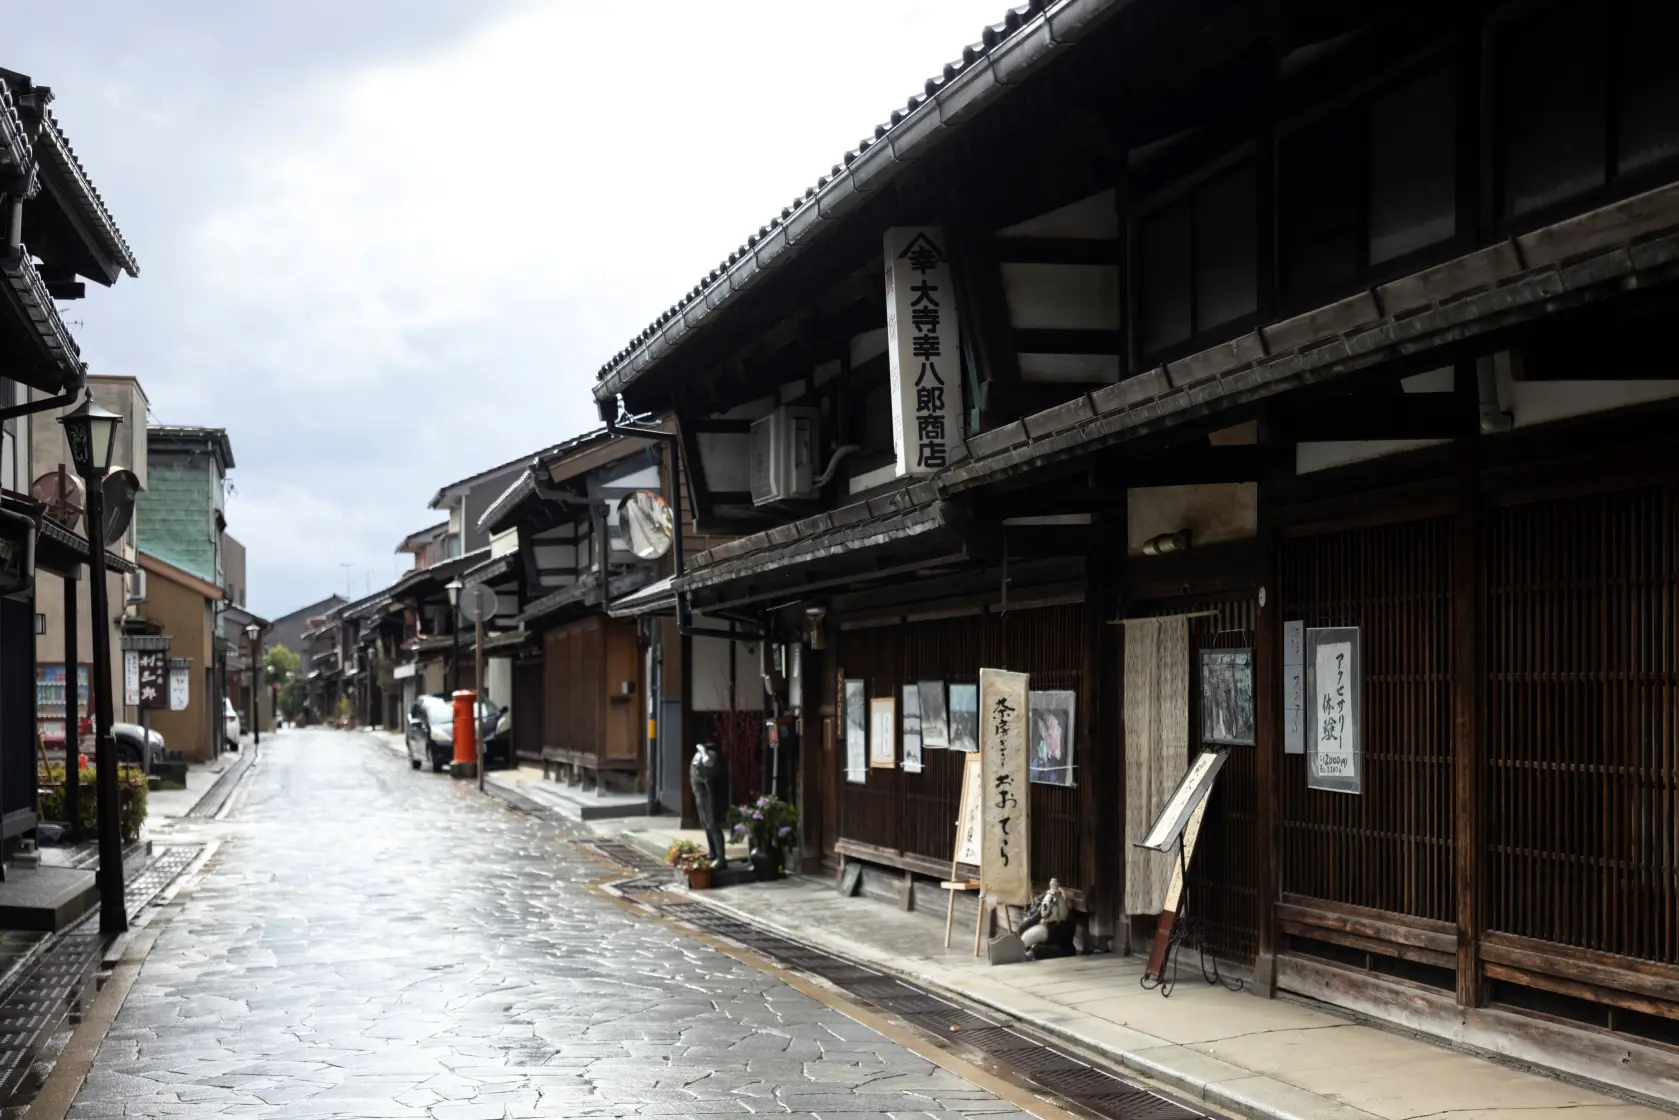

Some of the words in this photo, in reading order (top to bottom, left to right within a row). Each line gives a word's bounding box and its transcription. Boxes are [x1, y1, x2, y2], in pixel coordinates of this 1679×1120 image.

[910, 279, 947, 468] 大寺幸八郎商店
[1321, 693, 1338, 741] 体験
[1336, 653, 1346, 749] アクセサリー
